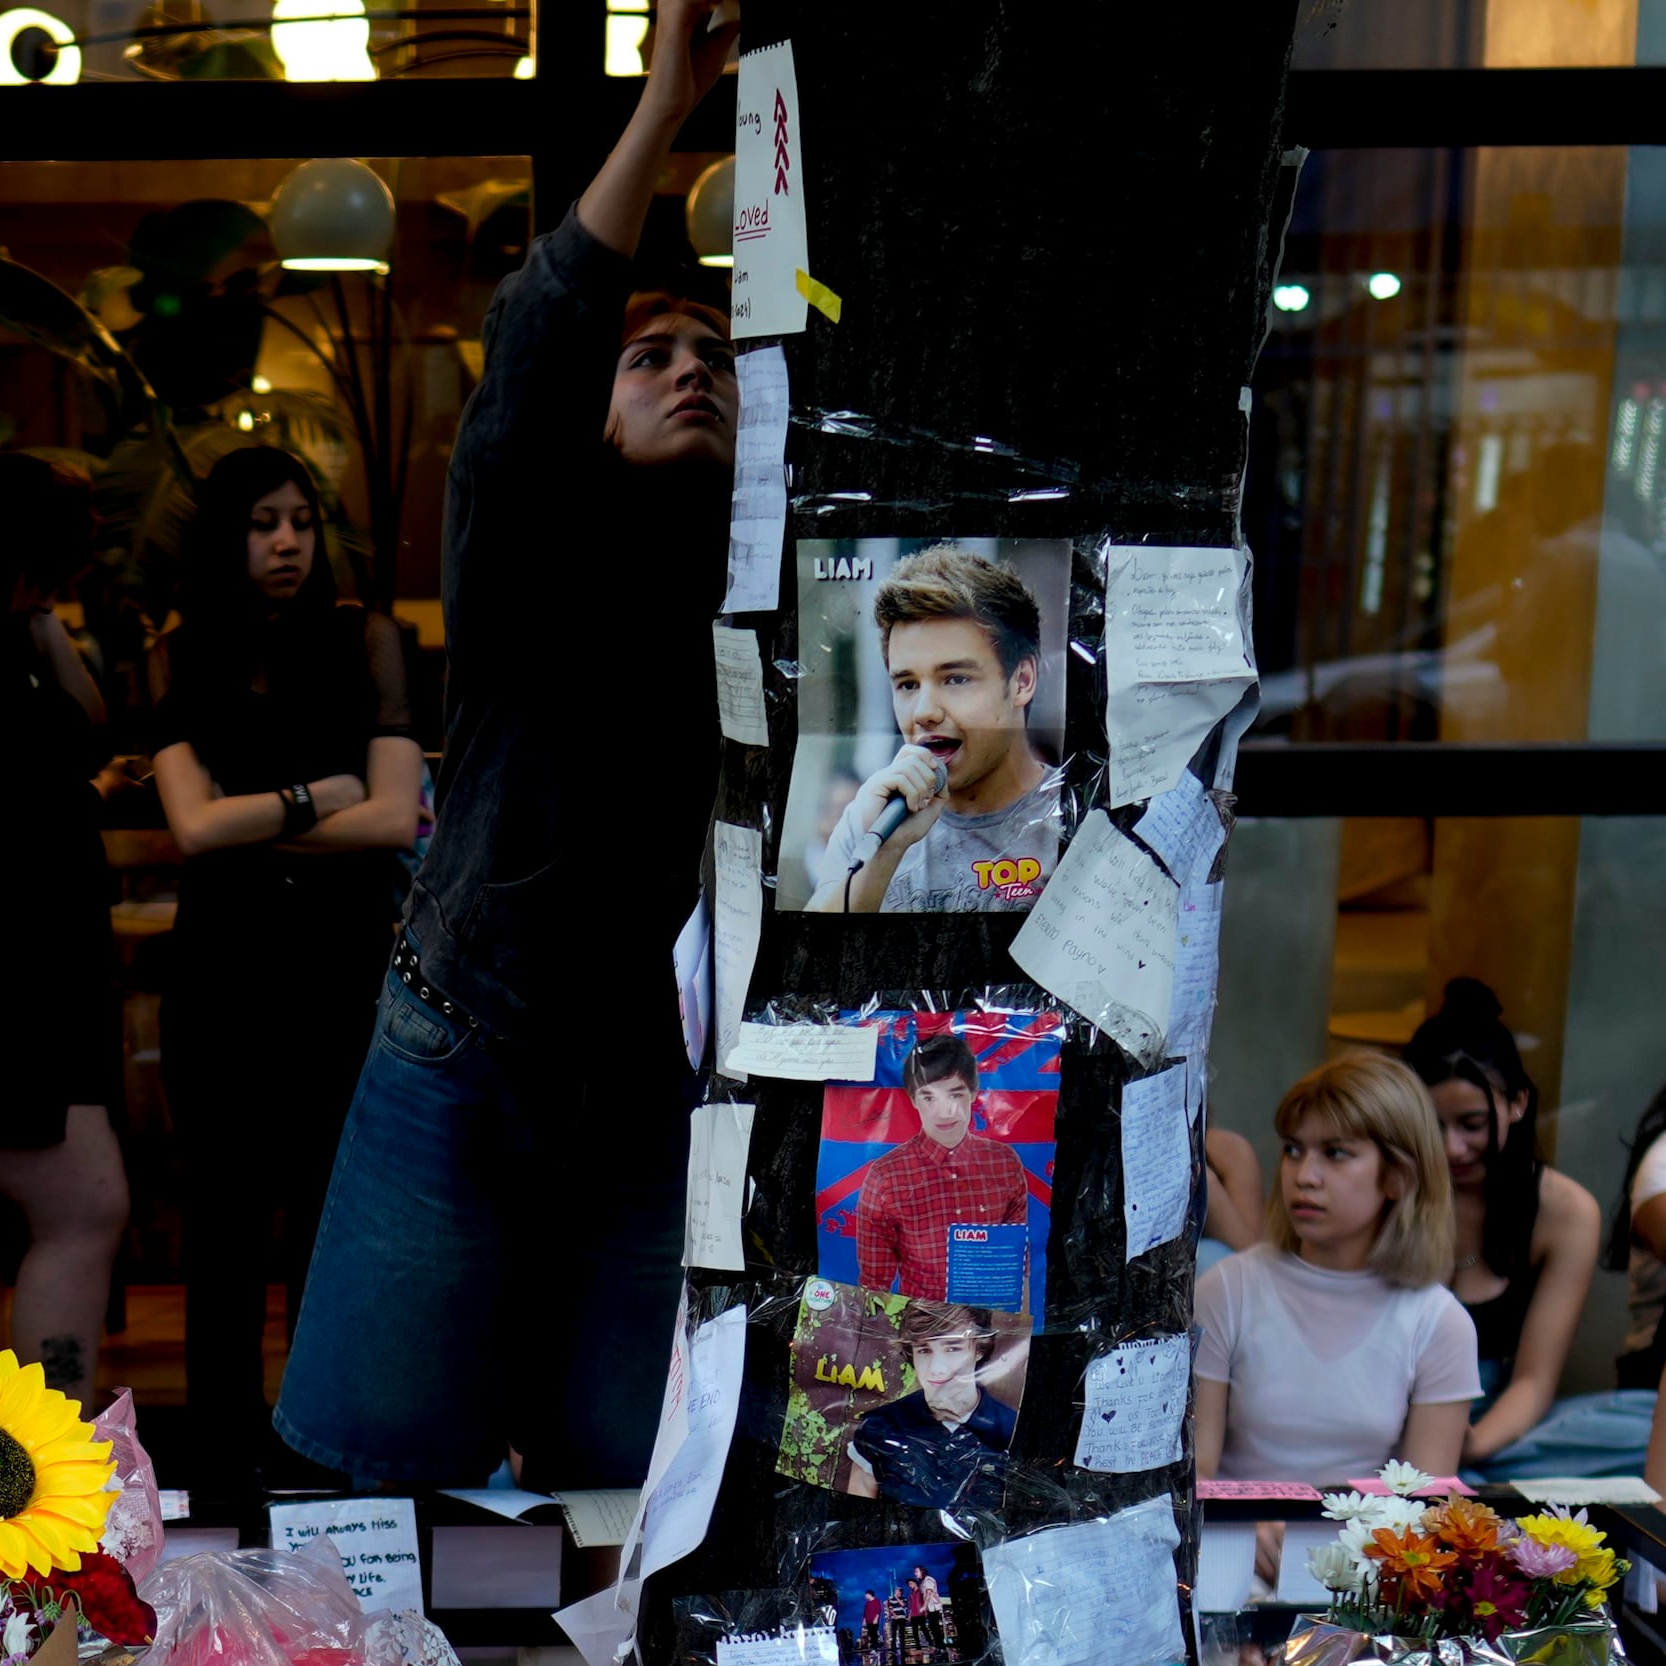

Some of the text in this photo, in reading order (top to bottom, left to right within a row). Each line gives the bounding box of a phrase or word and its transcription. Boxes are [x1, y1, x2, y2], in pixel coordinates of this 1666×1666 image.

[814, 557, 873, 580] LIAM
[972, 858, 1040, 889] TOP
[1000, 883, 1034, 900] Teen
[954, 1229, 988, 1242] LIAM
[286, 1528, 294, 1537] I
